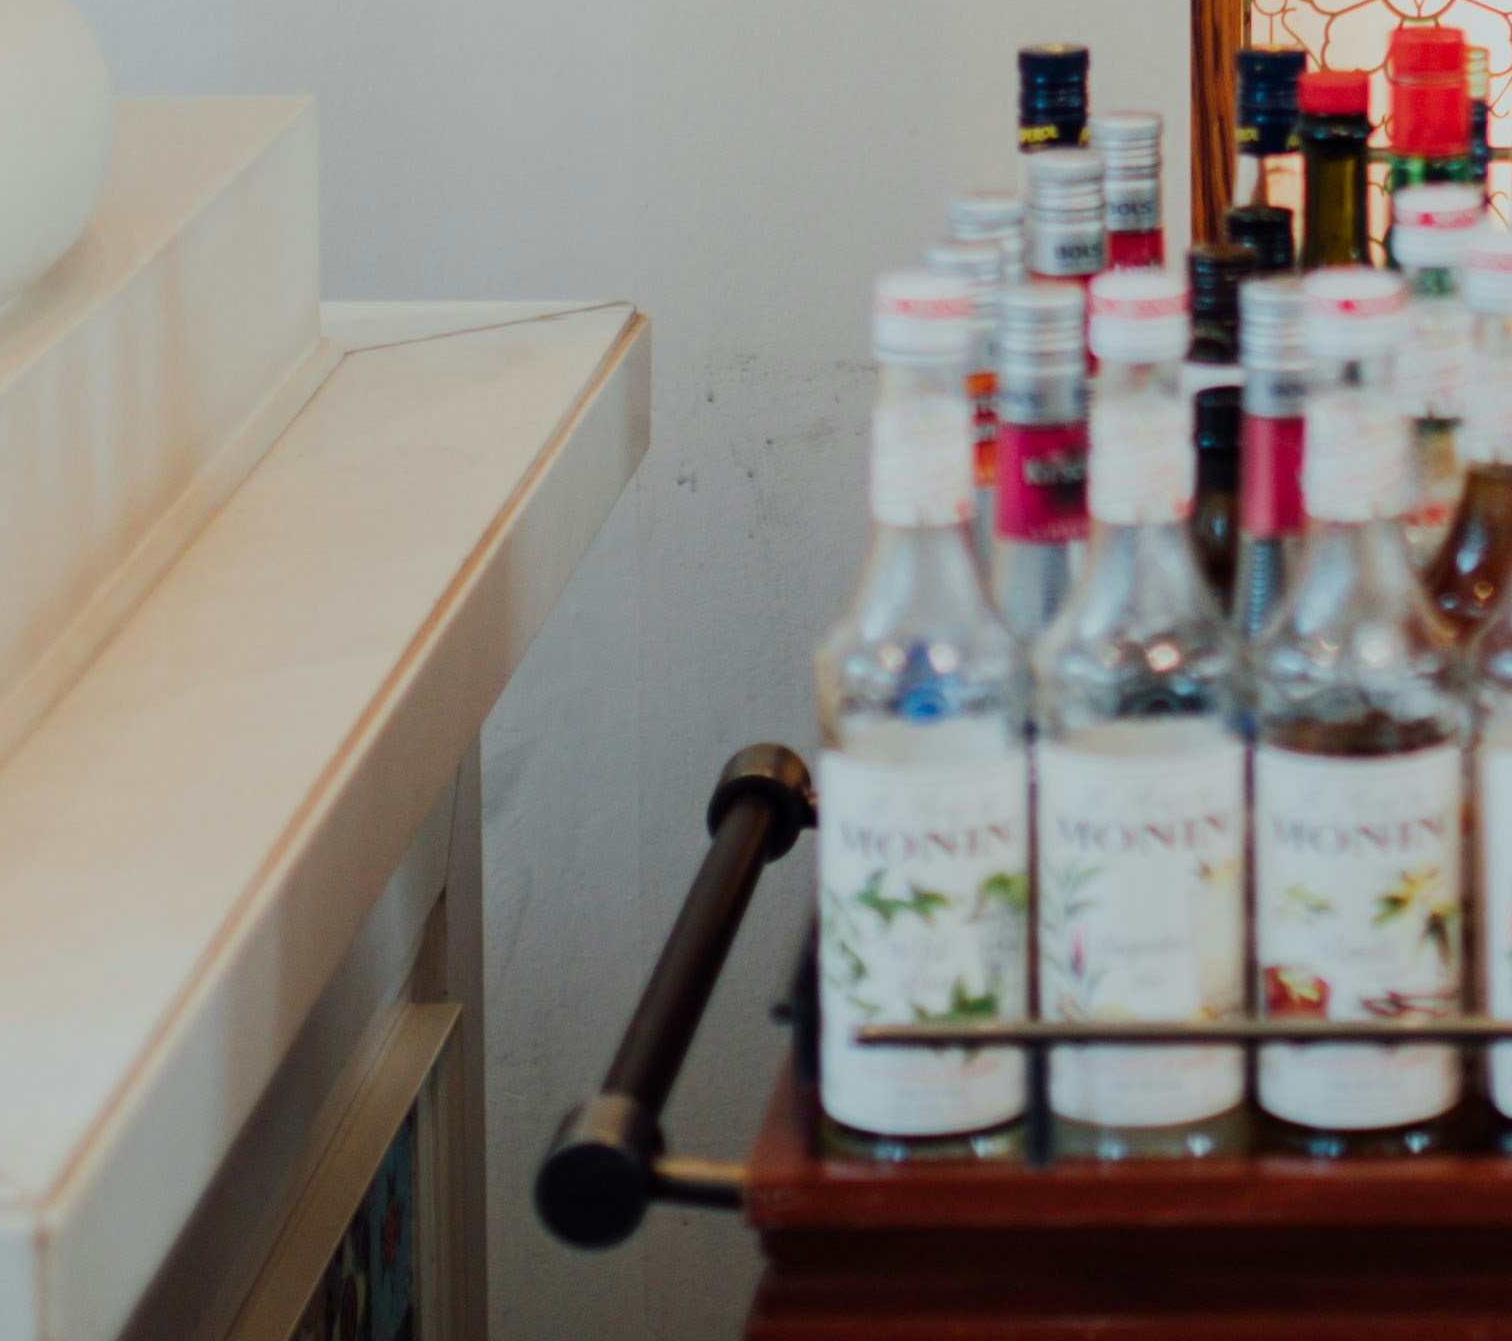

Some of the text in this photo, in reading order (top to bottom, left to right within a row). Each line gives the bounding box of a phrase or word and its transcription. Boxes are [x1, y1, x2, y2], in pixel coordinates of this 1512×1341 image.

[840, 818, 1012, 861] MONIN
[1056, 813, 1229, 857] MONIN
[1270, 812, 1448, 859] MONIN
